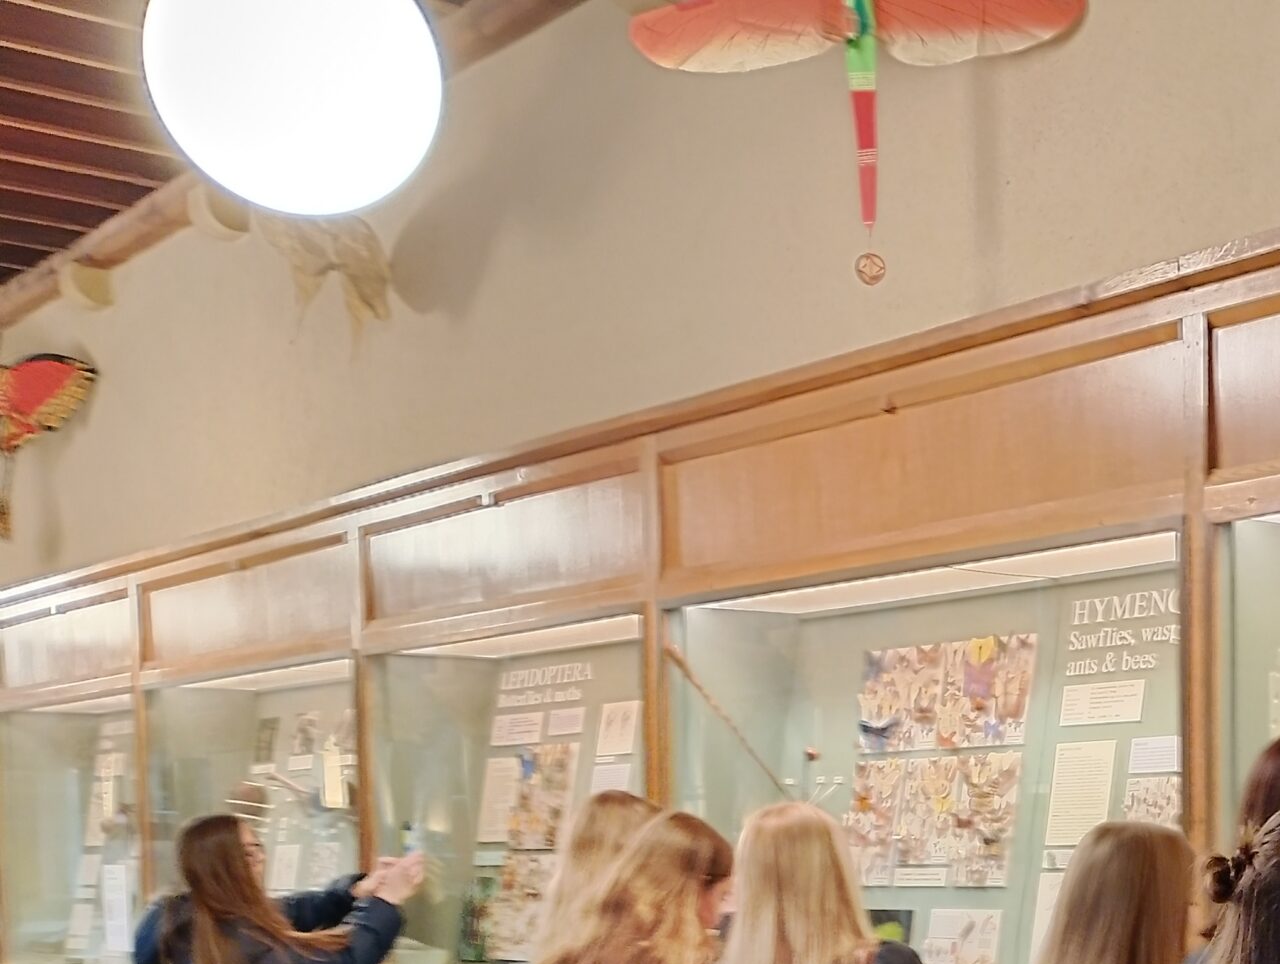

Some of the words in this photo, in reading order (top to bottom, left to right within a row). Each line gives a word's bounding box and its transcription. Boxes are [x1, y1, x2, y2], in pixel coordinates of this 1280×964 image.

[1068, 627, 1136, 650] Sawflies,
[501, 662, 592, 690] LEPIDOPTERA
[1066, 658, 1098, 676] ants
[1101, 652, 1117, 673] &
[1121, 651, 1157, 671] bees
